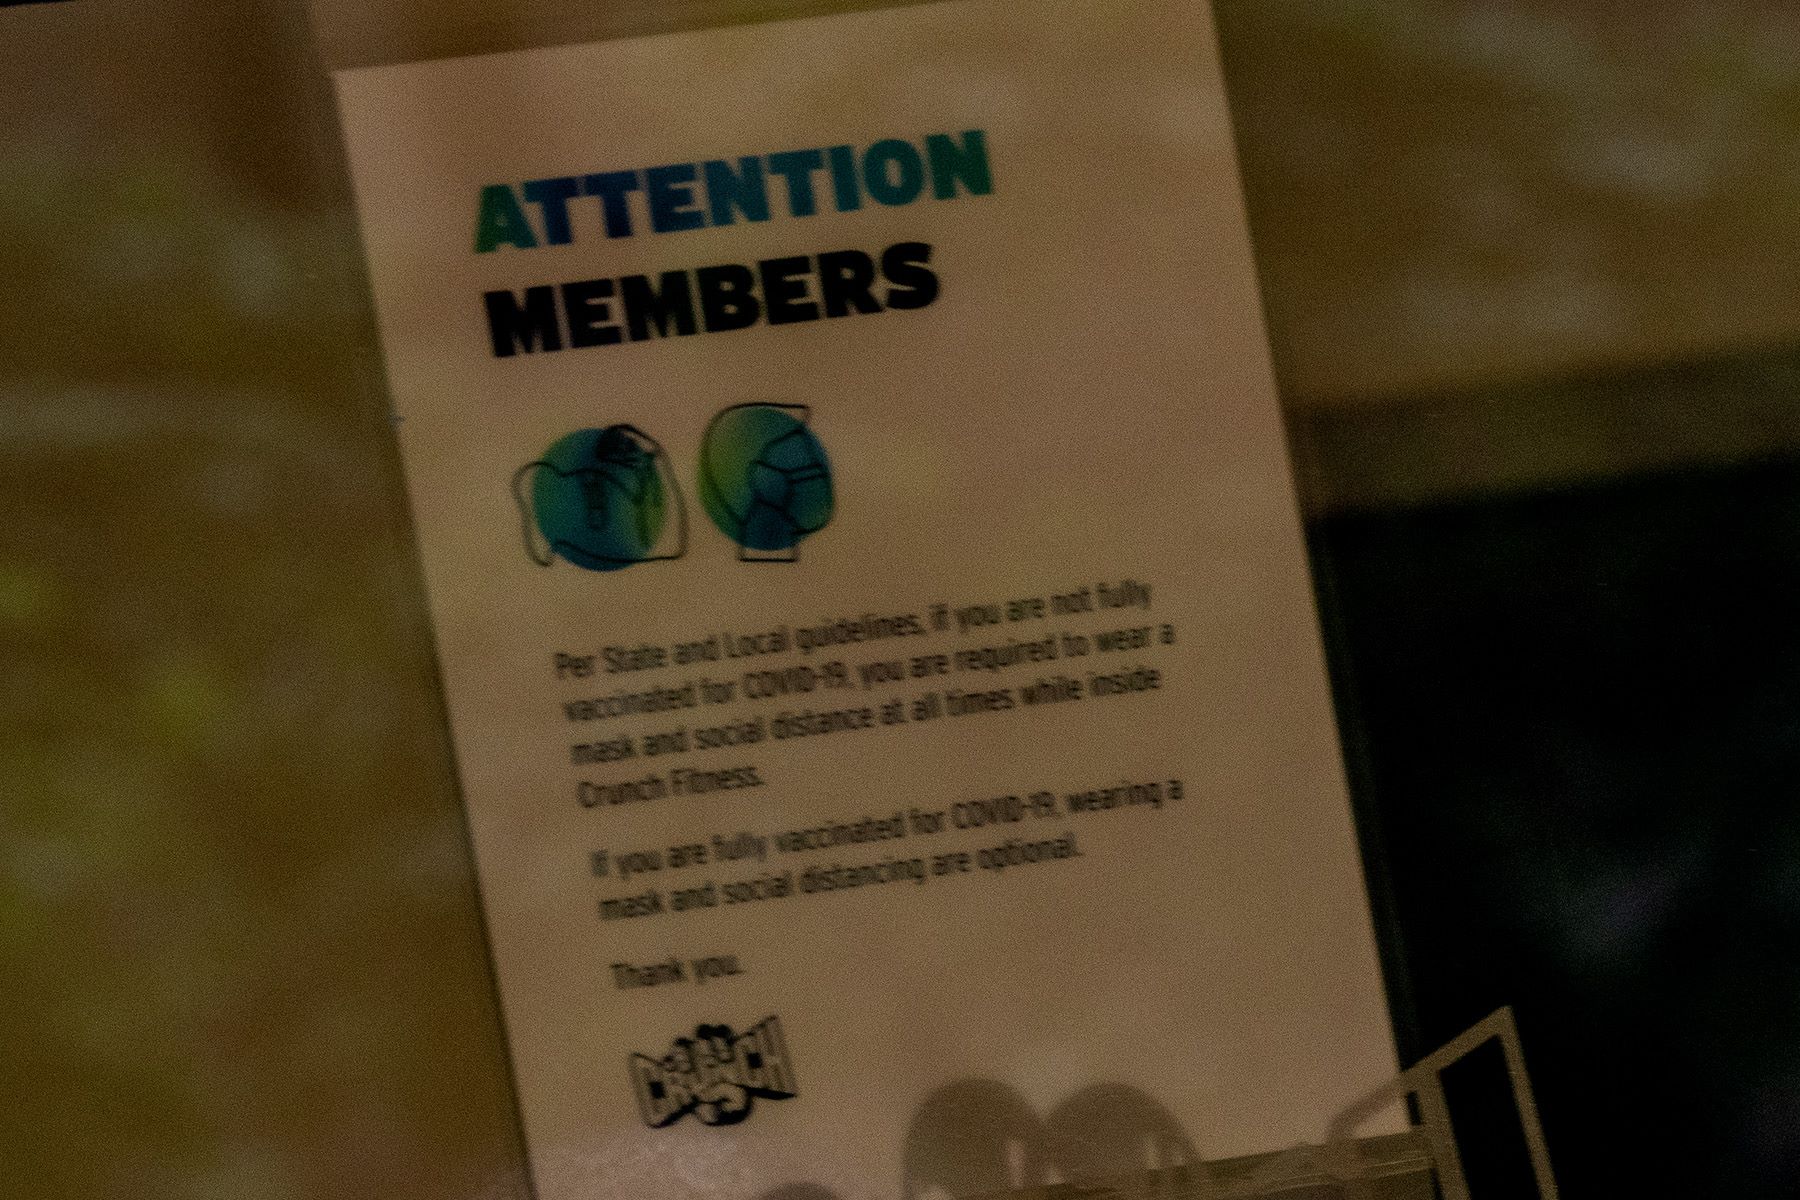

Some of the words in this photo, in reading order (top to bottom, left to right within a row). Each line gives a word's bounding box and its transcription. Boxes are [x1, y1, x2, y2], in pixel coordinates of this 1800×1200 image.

[473, 129, 995, 254] ATTENTION
[483, 241, 940, 357] MEMBERS
[554, 652, 597, 679] Per
[601, 642, 667, 674] State
[673, 635, 721, 666] and
[724, 624, 792, 660] Local
[930, 602, 950, 632] if
[953, 603, 1002, 634] you
[1006, 597, 1047, 624] are
[1051, 586, 1094, 616] not
[1096, 578, 1152, 610] fully
[562, 681, 697, 723] vaccinated
[698, 677, 737, 705] for
[857, 660, 907, 691] you
[909, 653, 951, 680] are
[953, 633, 1059, 674] required
[1061, 632, 1090, 659] to
[1093, 625, 1153, 653] wear
[1159, 623, 1176, 646] a
[571, 733, 639, 766] mask
[642, 725, 690, 758] and
[693, 715, 767, 751] social
[770, 706, 876, 741] distance
[879, 698, 908, 727] at
[911, 691, 943, 723] all
[944, 687, 1017, 718] times
[1018, 673, 1085, 707] while
[1088, 664, 1162, 698] inside
[577, 773, 669, 810] Crunch
[670, 765, 766, 796] Fitness.
[590, 849, 610, 878] If
[615, 850, 665, 881] you
[666, 842, 709, 870] are
[711, 831, 768, 862] fully
[774, 810, 907, 854] vaccinated
[908, 807, 947, 836] for
[1065, 779, 1164, 815] wearing
[1165, 778, 1185, 802] a
[598, 888, 667, 921] mask
[669, 880, 719, 913] and
[721, 869, 796, 906] social
[798, 855, 928, 896] distancing
[931, 851, 973, 878] are
[976, 831, 1084, 873] optional.
[609, 956, 689, 990] Thank
[629, 1015, 798, 1129] CRUNCH
